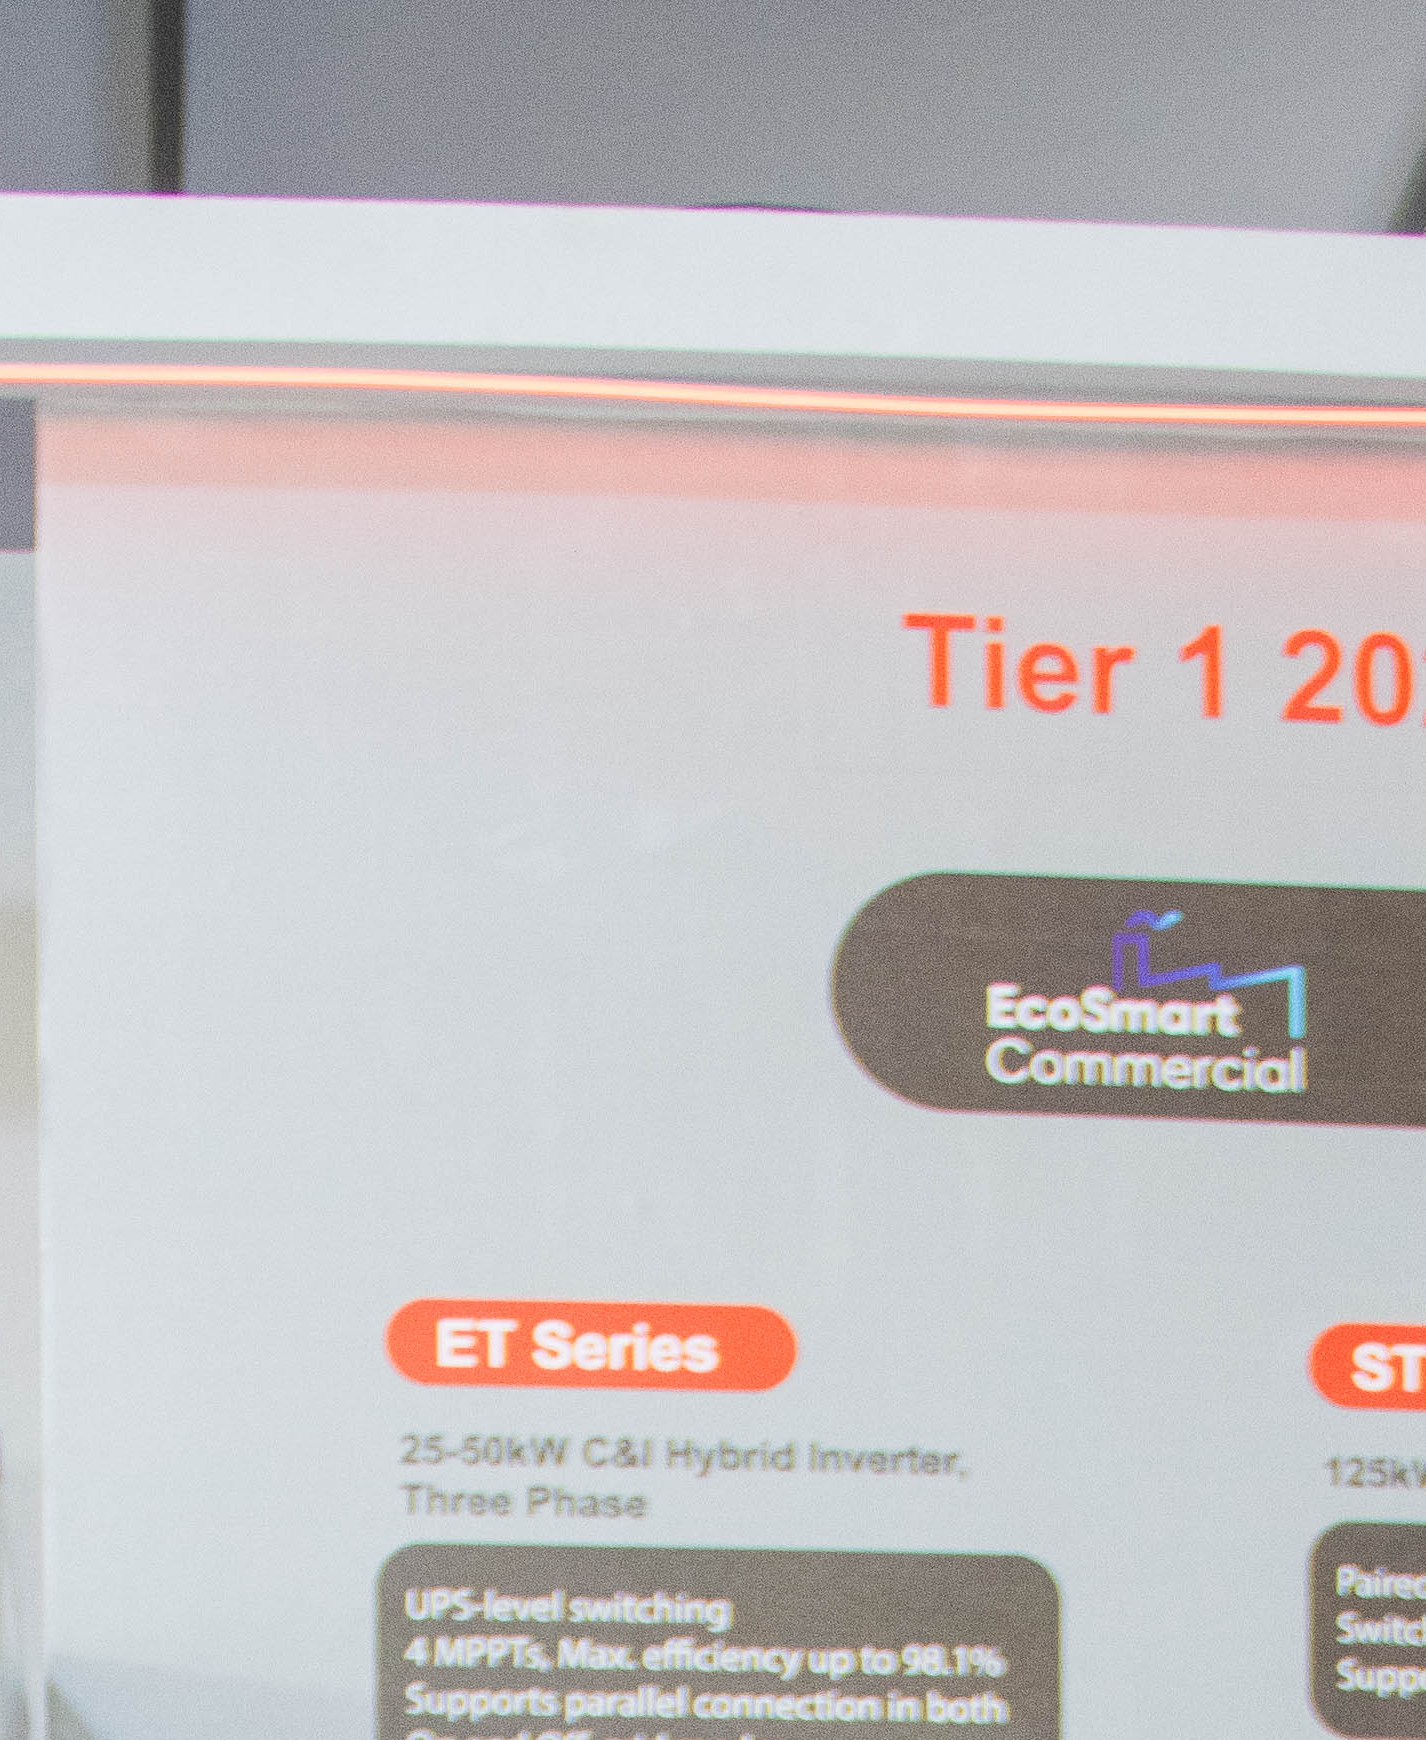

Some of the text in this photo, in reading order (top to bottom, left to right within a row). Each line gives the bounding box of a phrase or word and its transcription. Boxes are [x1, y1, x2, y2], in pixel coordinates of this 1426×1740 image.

[903, 612, 1135, 713] Tier
[1182, 625, 1222, 717] 1
[988, 976, 1244, 1036] EcoSmart
[987, 1037, 1304, 1092] Commercial
[437, 1318, 718, 1373] ET Series
[401, 1434, 966, 1477] 25-50kW C&I Hybrid Inverter,
[402, 1483, 648, 1519] Three Phase
[407, 1588, 731, 1633] UPS-level switching
[405, 1636, 1006, 1680] 4 MPPTs, Max. efficiency up to 98.1%
[406, 1682, 1007, 1724] Supports parallel connection in both
